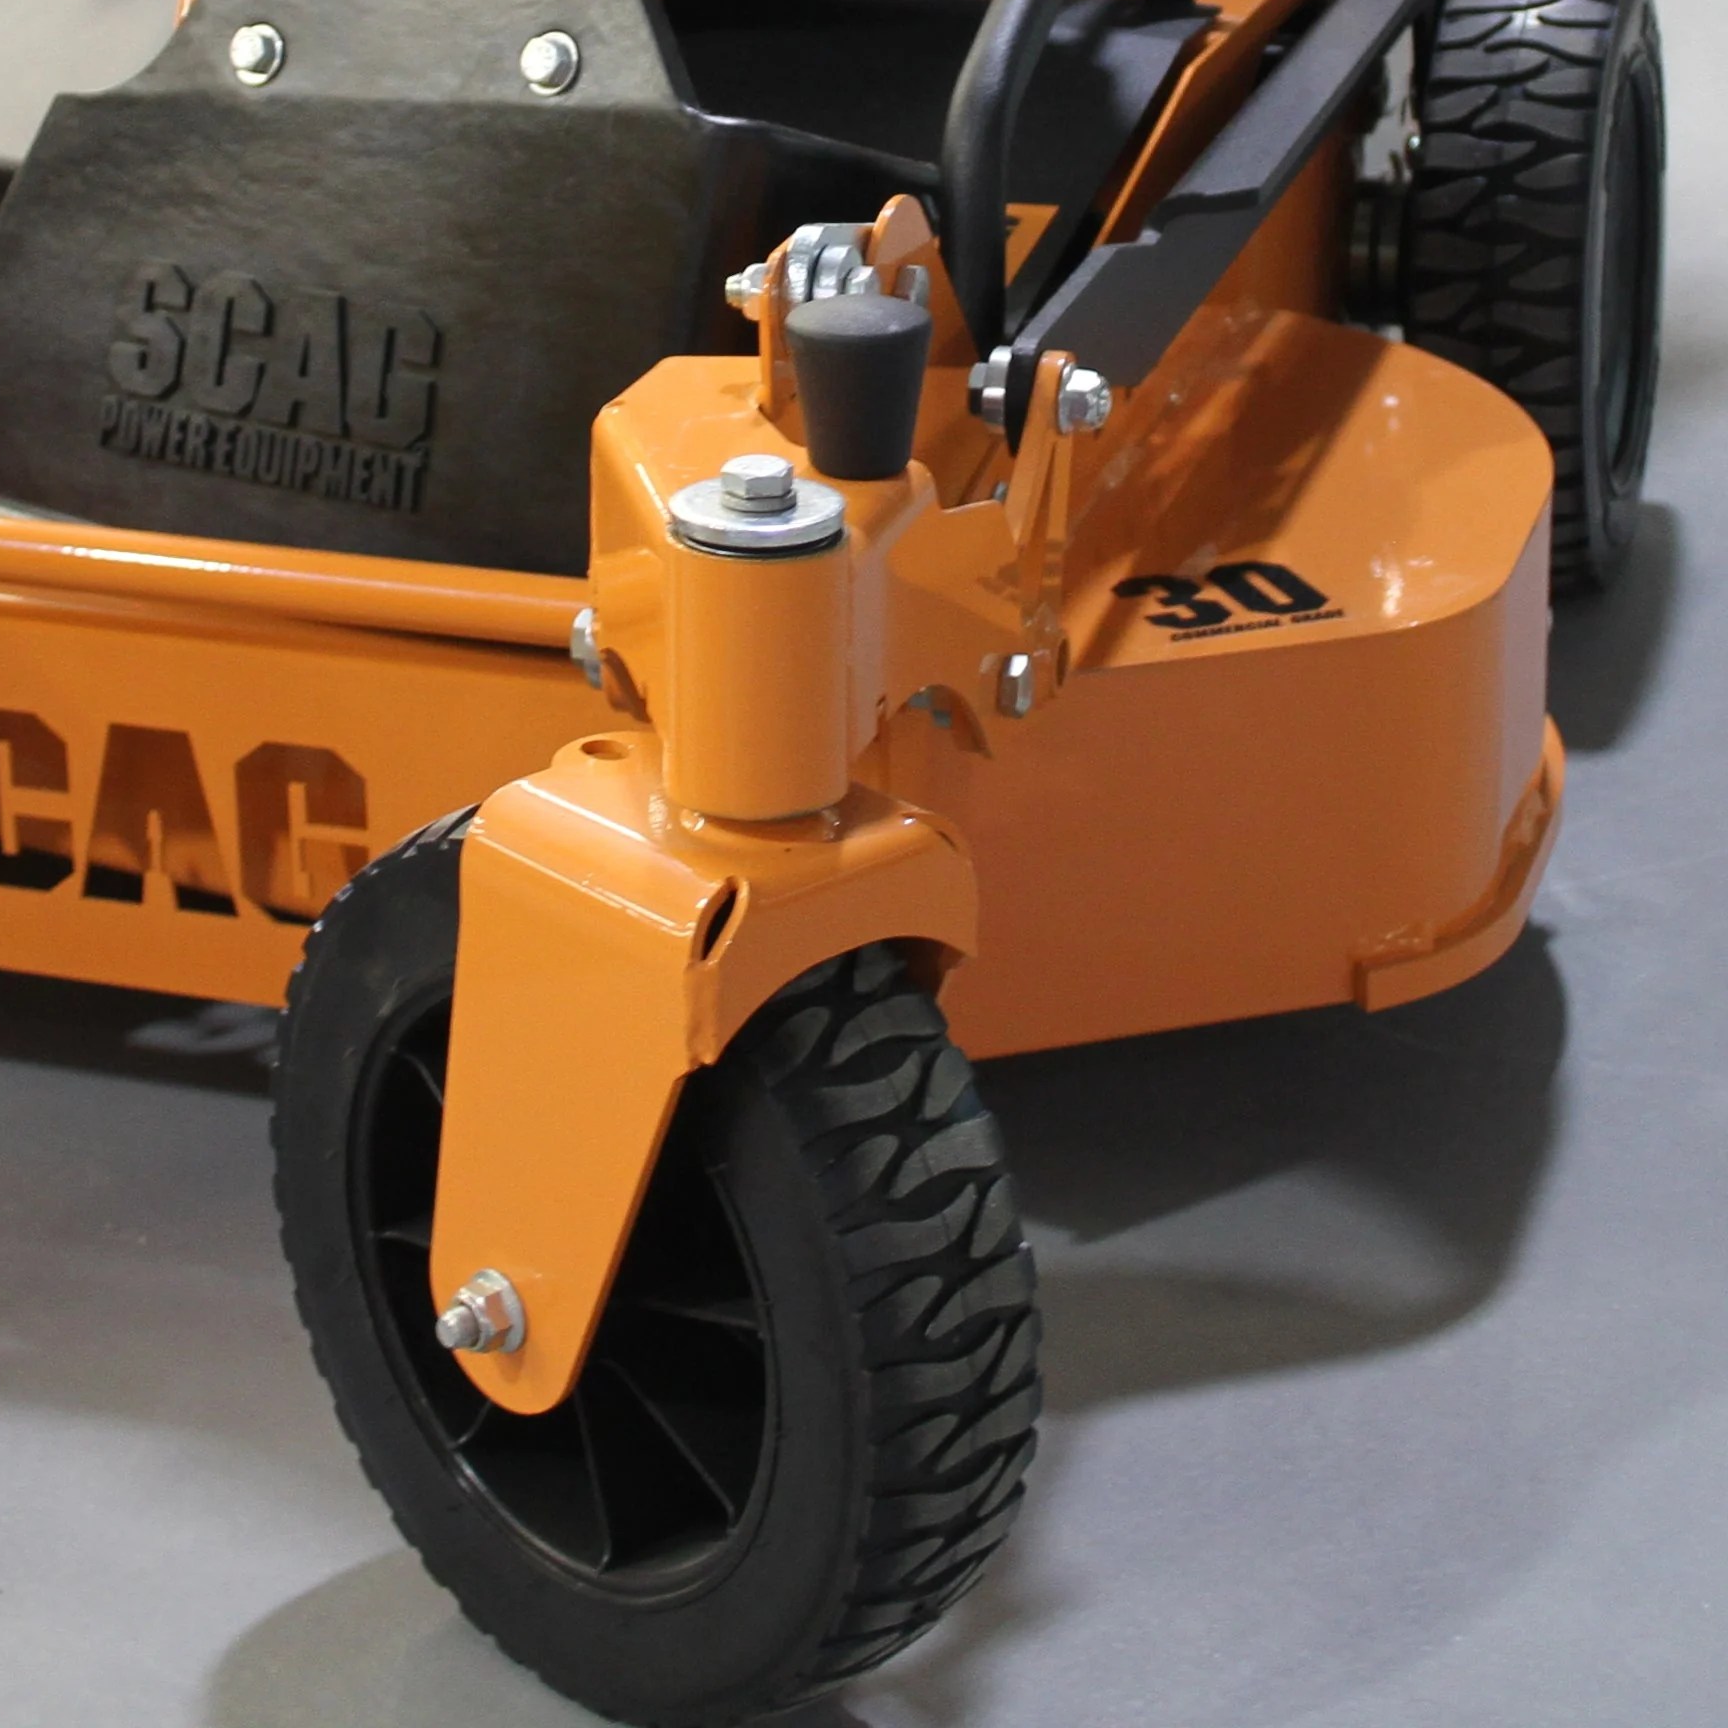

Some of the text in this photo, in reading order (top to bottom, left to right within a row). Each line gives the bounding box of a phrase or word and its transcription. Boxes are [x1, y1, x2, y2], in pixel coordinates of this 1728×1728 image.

[107, 262, 444, 453] SCAG
[99, 393, 431, 514] POWER EQUIPMENT
[1112, 560, 1329, 629] 30
[1170, 616, 1281, 642] COMMERCIAL
